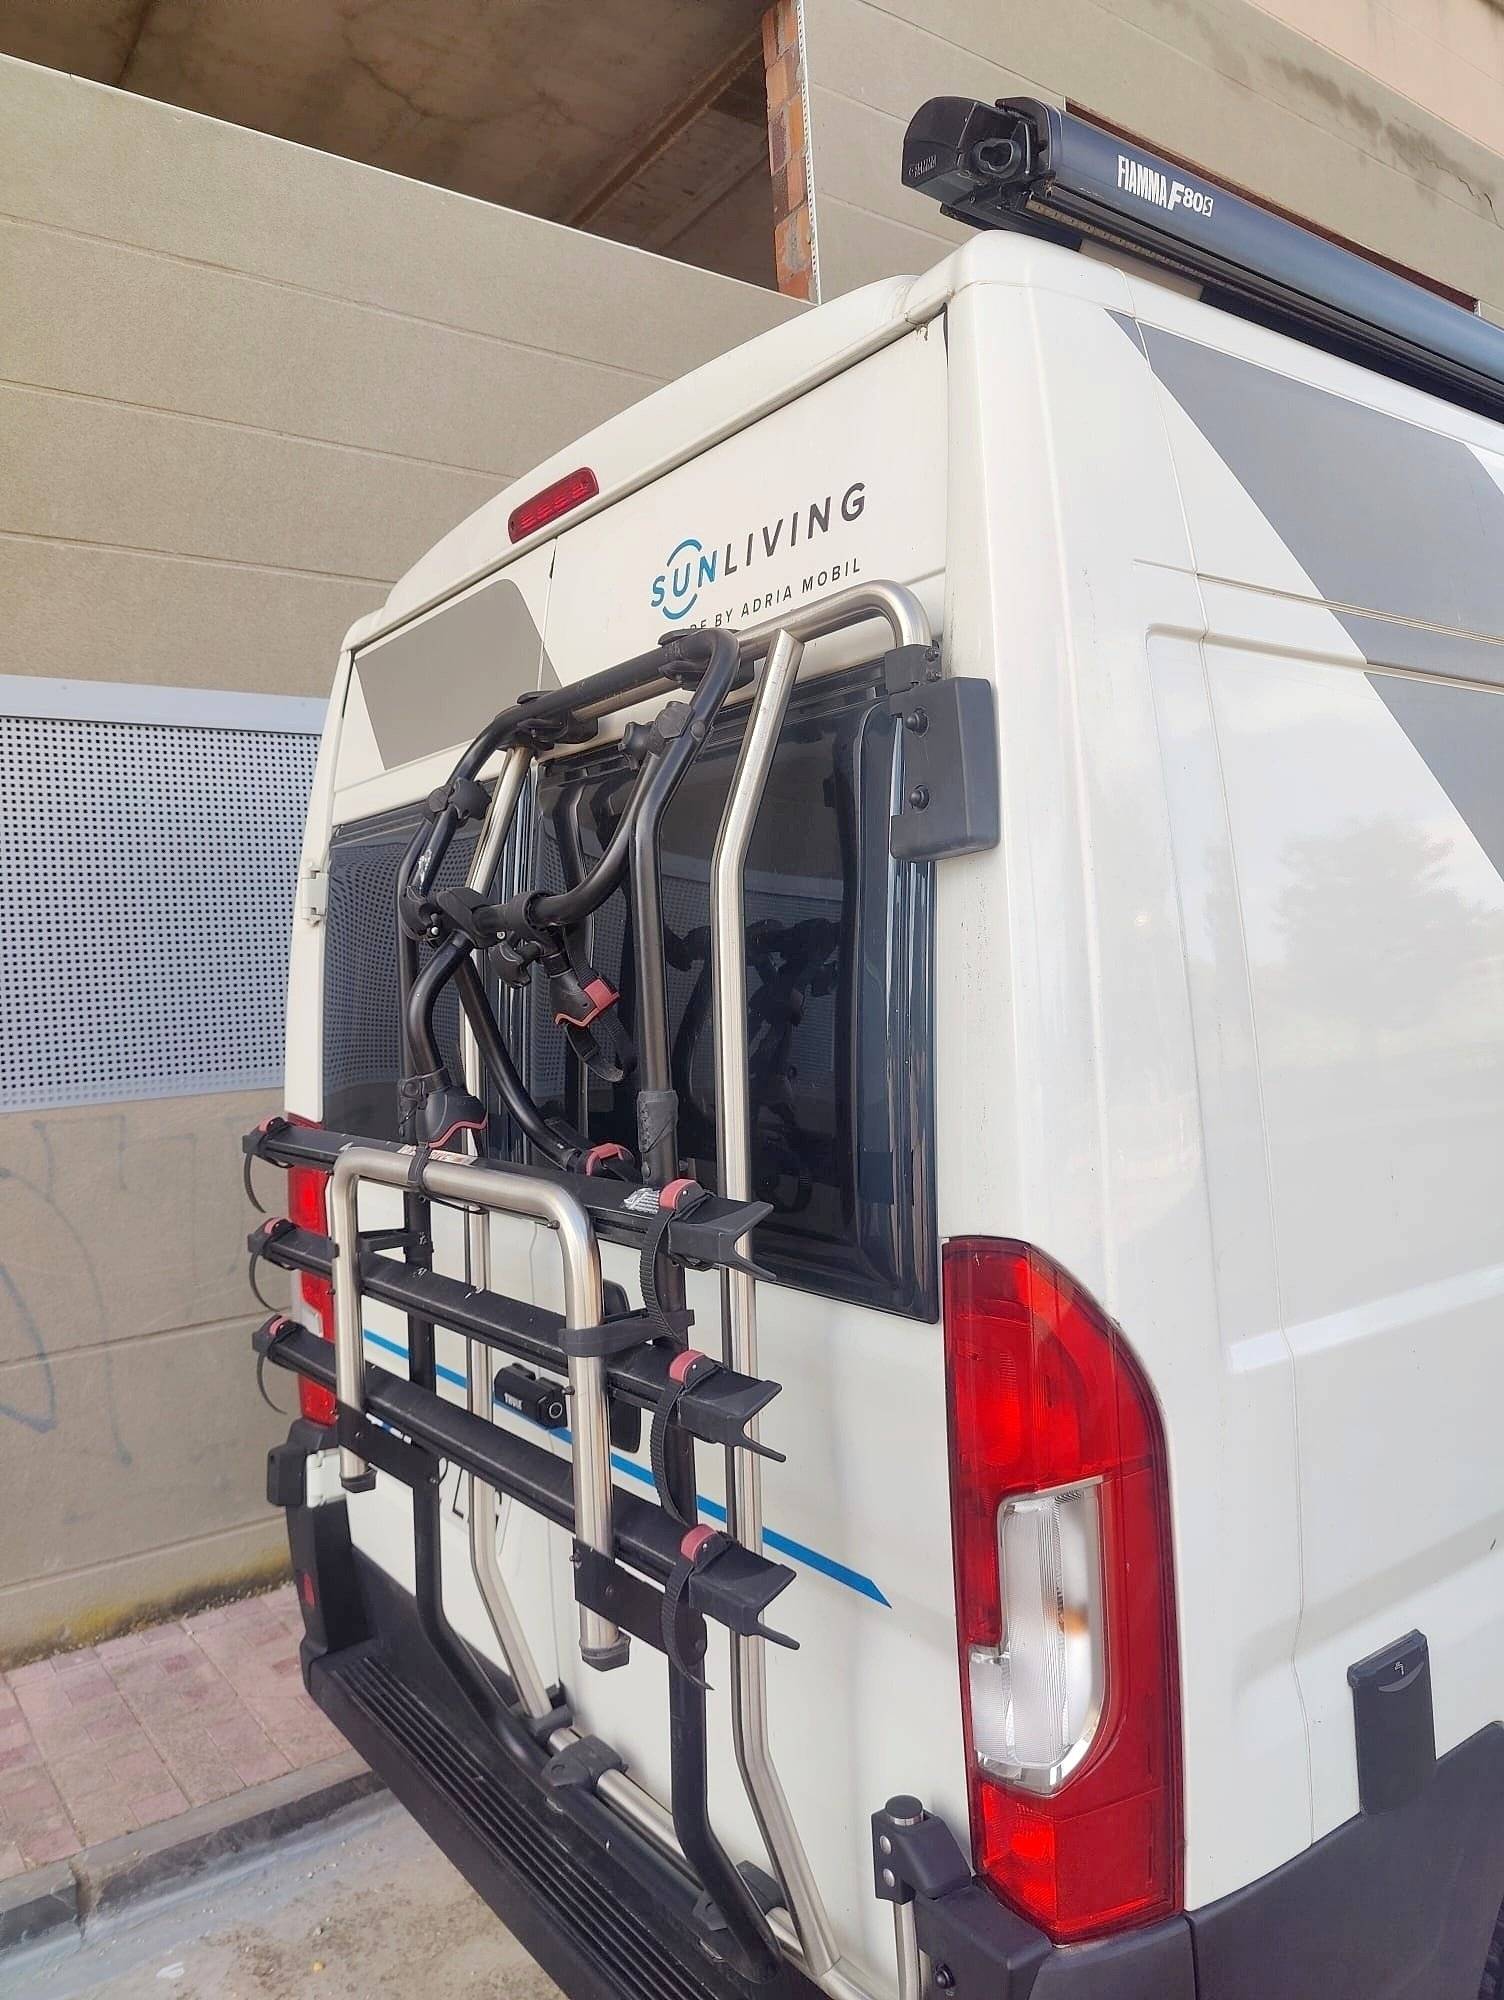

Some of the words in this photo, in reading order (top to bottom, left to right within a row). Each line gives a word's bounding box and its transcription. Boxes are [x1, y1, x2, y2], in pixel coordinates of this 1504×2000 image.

[1117, 154, 1168, 209] FIAMMA
[650, 482, 866, 608] SUNLIVING
[714, 607, 733, 628] BY
[740, 585, 793, 619] ADRIA
[801, 557, 861, 594] MOBIL
